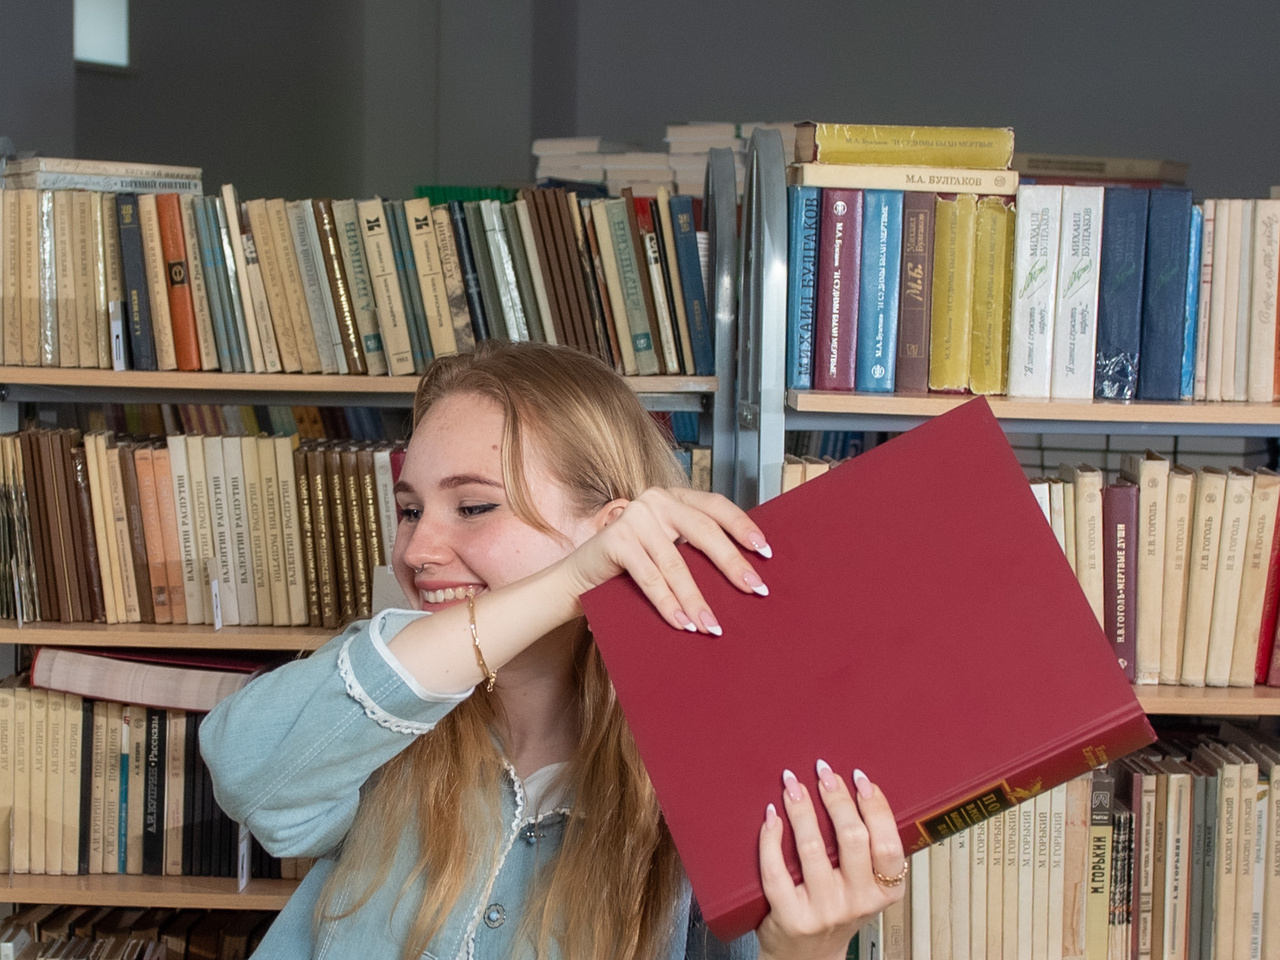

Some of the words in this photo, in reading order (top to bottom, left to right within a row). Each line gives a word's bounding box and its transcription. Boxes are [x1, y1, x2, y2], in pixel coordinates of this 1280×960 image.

[906, 175, 926, 184] М.А.
[929, 176, 982, 186] БУЛГАКОВ
[802, 198, 818, 289] БУЛГАКОВ
[907, 217, 916, 252] Михаил
[916, 214, 925, 252] Булгаков
[1030, 213, 1039, 257] МИХАИЛ
[1040, 208, 1050, 257] БУЛГАКОВ
[1072, 212, 1080, 257] МИХАИЛ
[1082, 208, 1091, 257] БУЛГАКОВ
[345, 221, 368, 298] ПУШКИН
[615, 221, 636, 297] ПУШКИН
[798, 295, 813, 376] МИХАИЛ
[177, 475, 189, 526] РАСПУТИН
[196, 481, 207, 529] РАСПУТИН
[213, 476, 224, 527] РАСПУТИН
[232, 476, 242, 527] РАСПУТИН
[249, 483, 260, 531] РАСПУТИН
[281, 480, 292, 529] РАСПУТИН
[315, 475, 323, 499] ПРОЗА
[265, 477, 276, 529] ВАЛЕНТИН
[271, 534, 281, 582] РАСПУТИН
[1088, 516, 1096, 550] ГОГОЛЬ
[1117, 524, 1126, 548] ДУШИ
[1149, 502, 1157, 536] ГОГОЛЬ
[1176, 517, 1184, 551] ГОГОЛЬ
[1203, 517, 1212, 551] ГОГОЛЬ
[1229, 517, 1240, 552] ГОГОЛЬ
[1255, 515, 1266, 550] ГОГОЛЬ
[183, 531, 194, 582] ВАЛЕНТИН
[201, 533, 210, 585] ВАЛЕНТИН
[219, 532, 230, 583] ВАЛЕНТИН
[237, 532, 248, 584] ВАЛЕНТИН
[253, 535, 265, 588] ВАЛЕНТИН
[286, 533, 296, 585] ВАЛЕНТИН
[109, 727, 117, 781] ПОЕДИНОК
[149, 716, 159, 761] Рассказы
[148, 767, 158, 813] КУПРИН
[994, 814, 1002, 853] ГОРЬКИ
[1008, 810, 1016, 854] ГОРЬКИЙ
[1022, 811, 1031, 855] ГОРЬКИЙ
[1039, 812, 1047, 856] ГОРЬКИЙ
[1054, 812, 1062, 856] ГОРЬКИЙ
[1243, 798, 1252, 835] ГОРЬКИЙ
[1225, 838, 1233, 874] МАКСИМ
[1243, 839, 1251, 875] МАКСИМ
